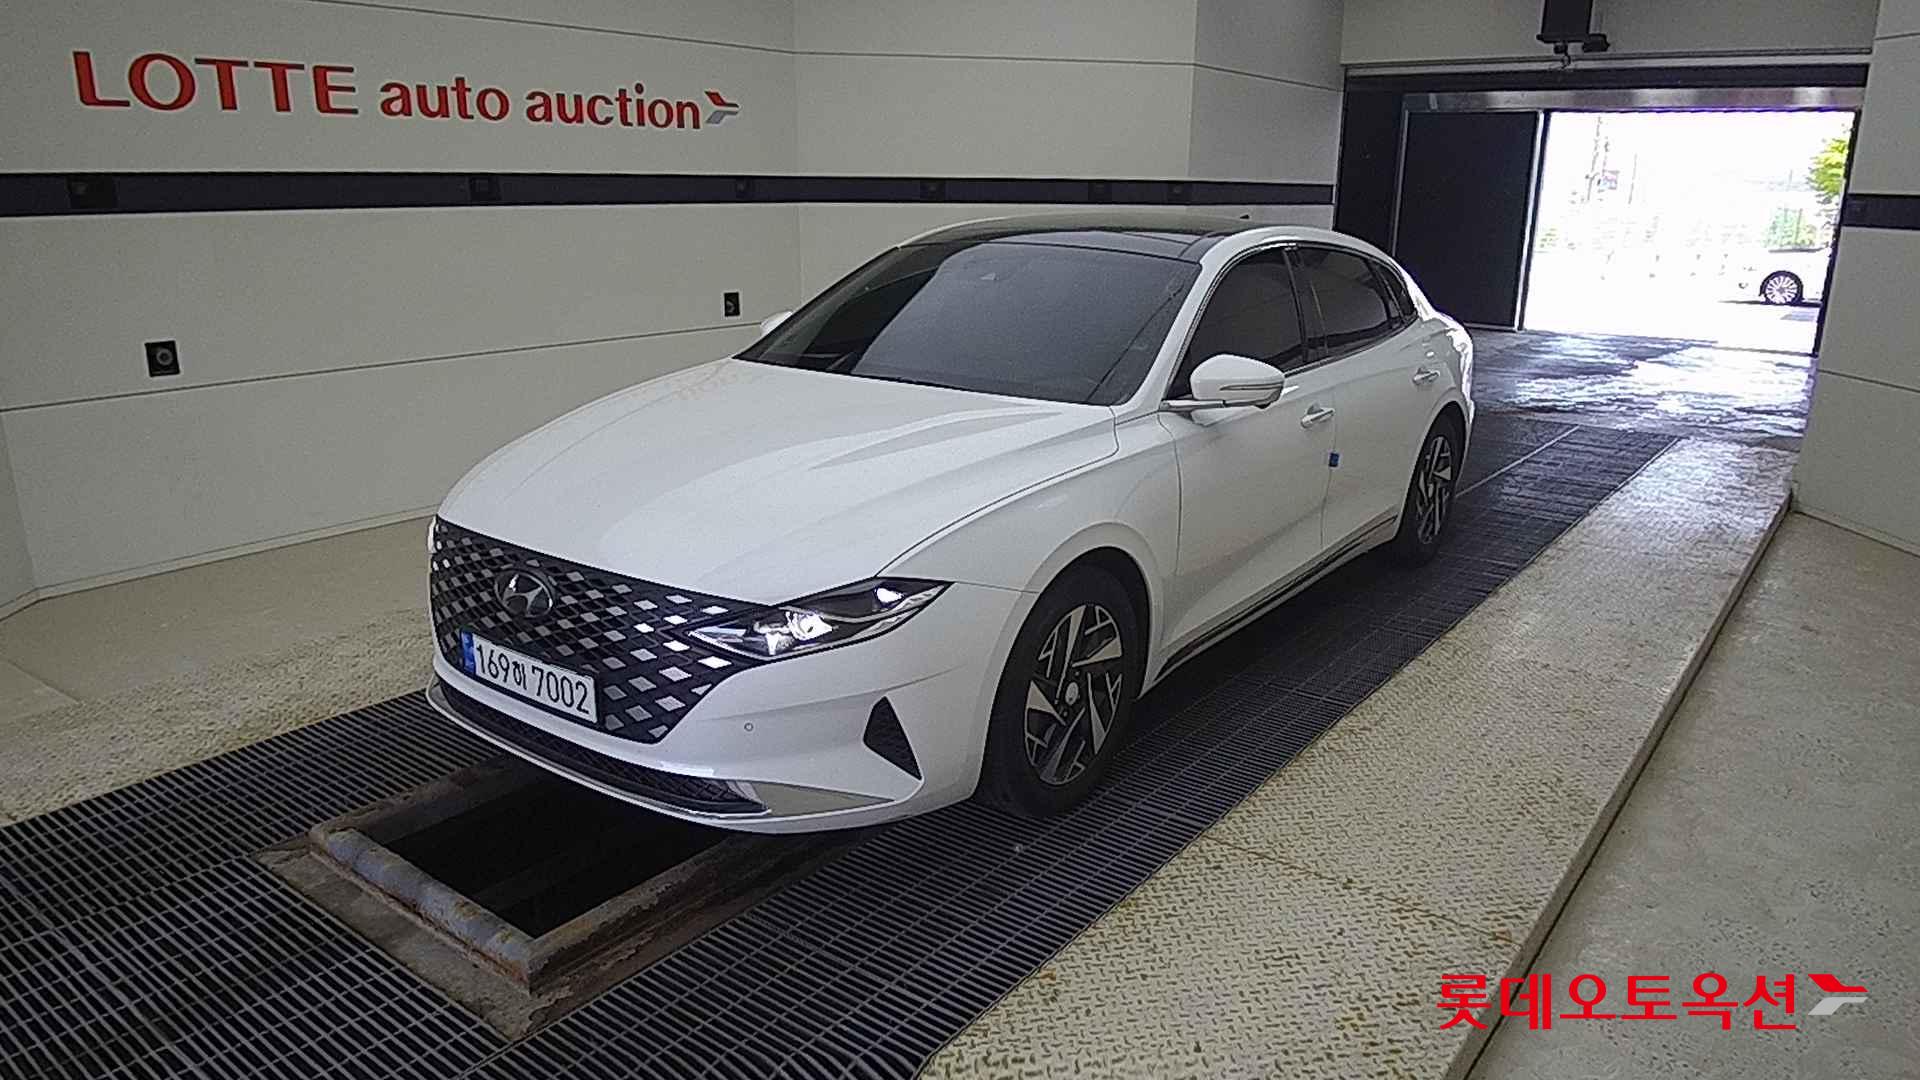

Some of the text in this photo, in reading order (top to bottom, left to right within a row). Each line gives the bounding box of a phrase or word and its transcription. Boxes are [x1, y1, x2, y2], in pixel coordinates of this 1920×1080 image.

[74, 51, 702, 130] LOTTE auto auction
[531, 664, 590, 715] 7002
